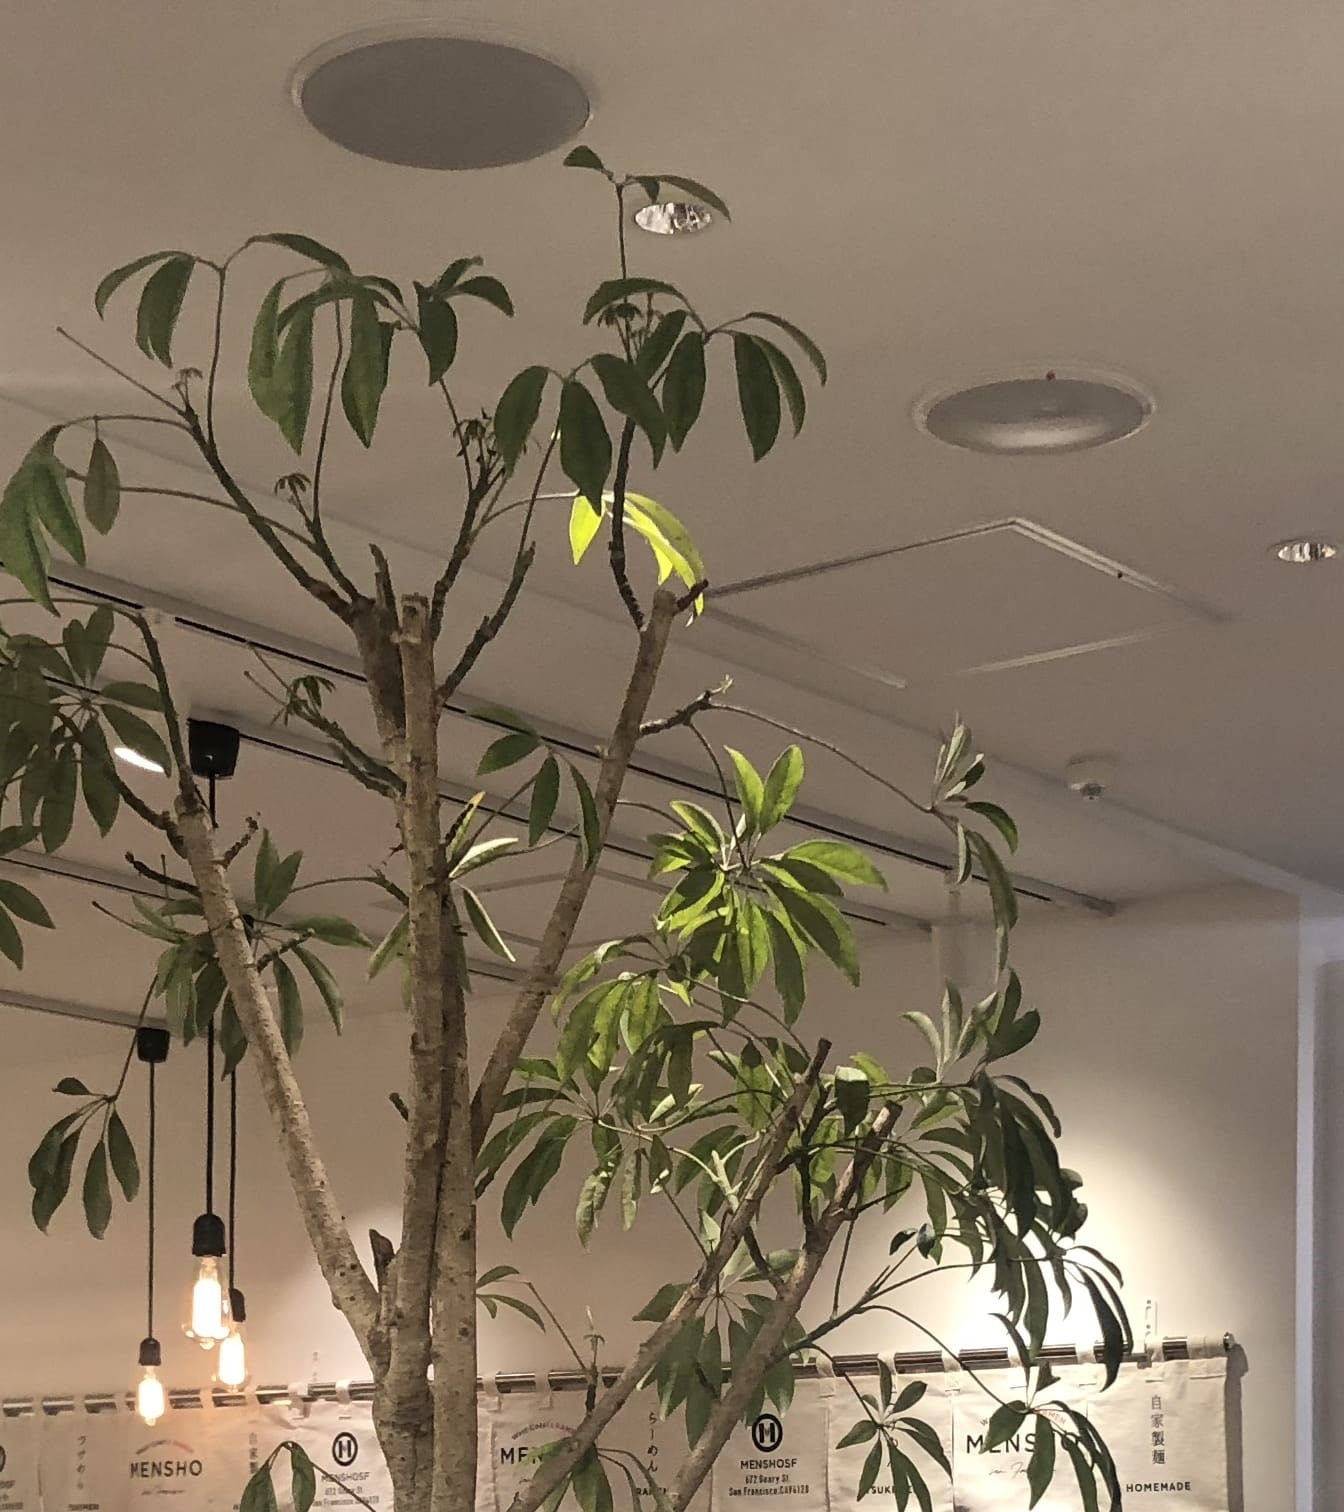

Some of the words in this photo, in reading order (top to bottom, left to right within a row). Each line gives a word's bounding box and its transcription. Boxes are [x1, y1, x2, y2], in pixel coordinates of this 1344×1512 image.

[130, 1460, 203, 1479] MENSHO
[740, 1458, 797, 1470] MENSHOSF
[1126, 1481, 1191, 1493] HOMEMADE
